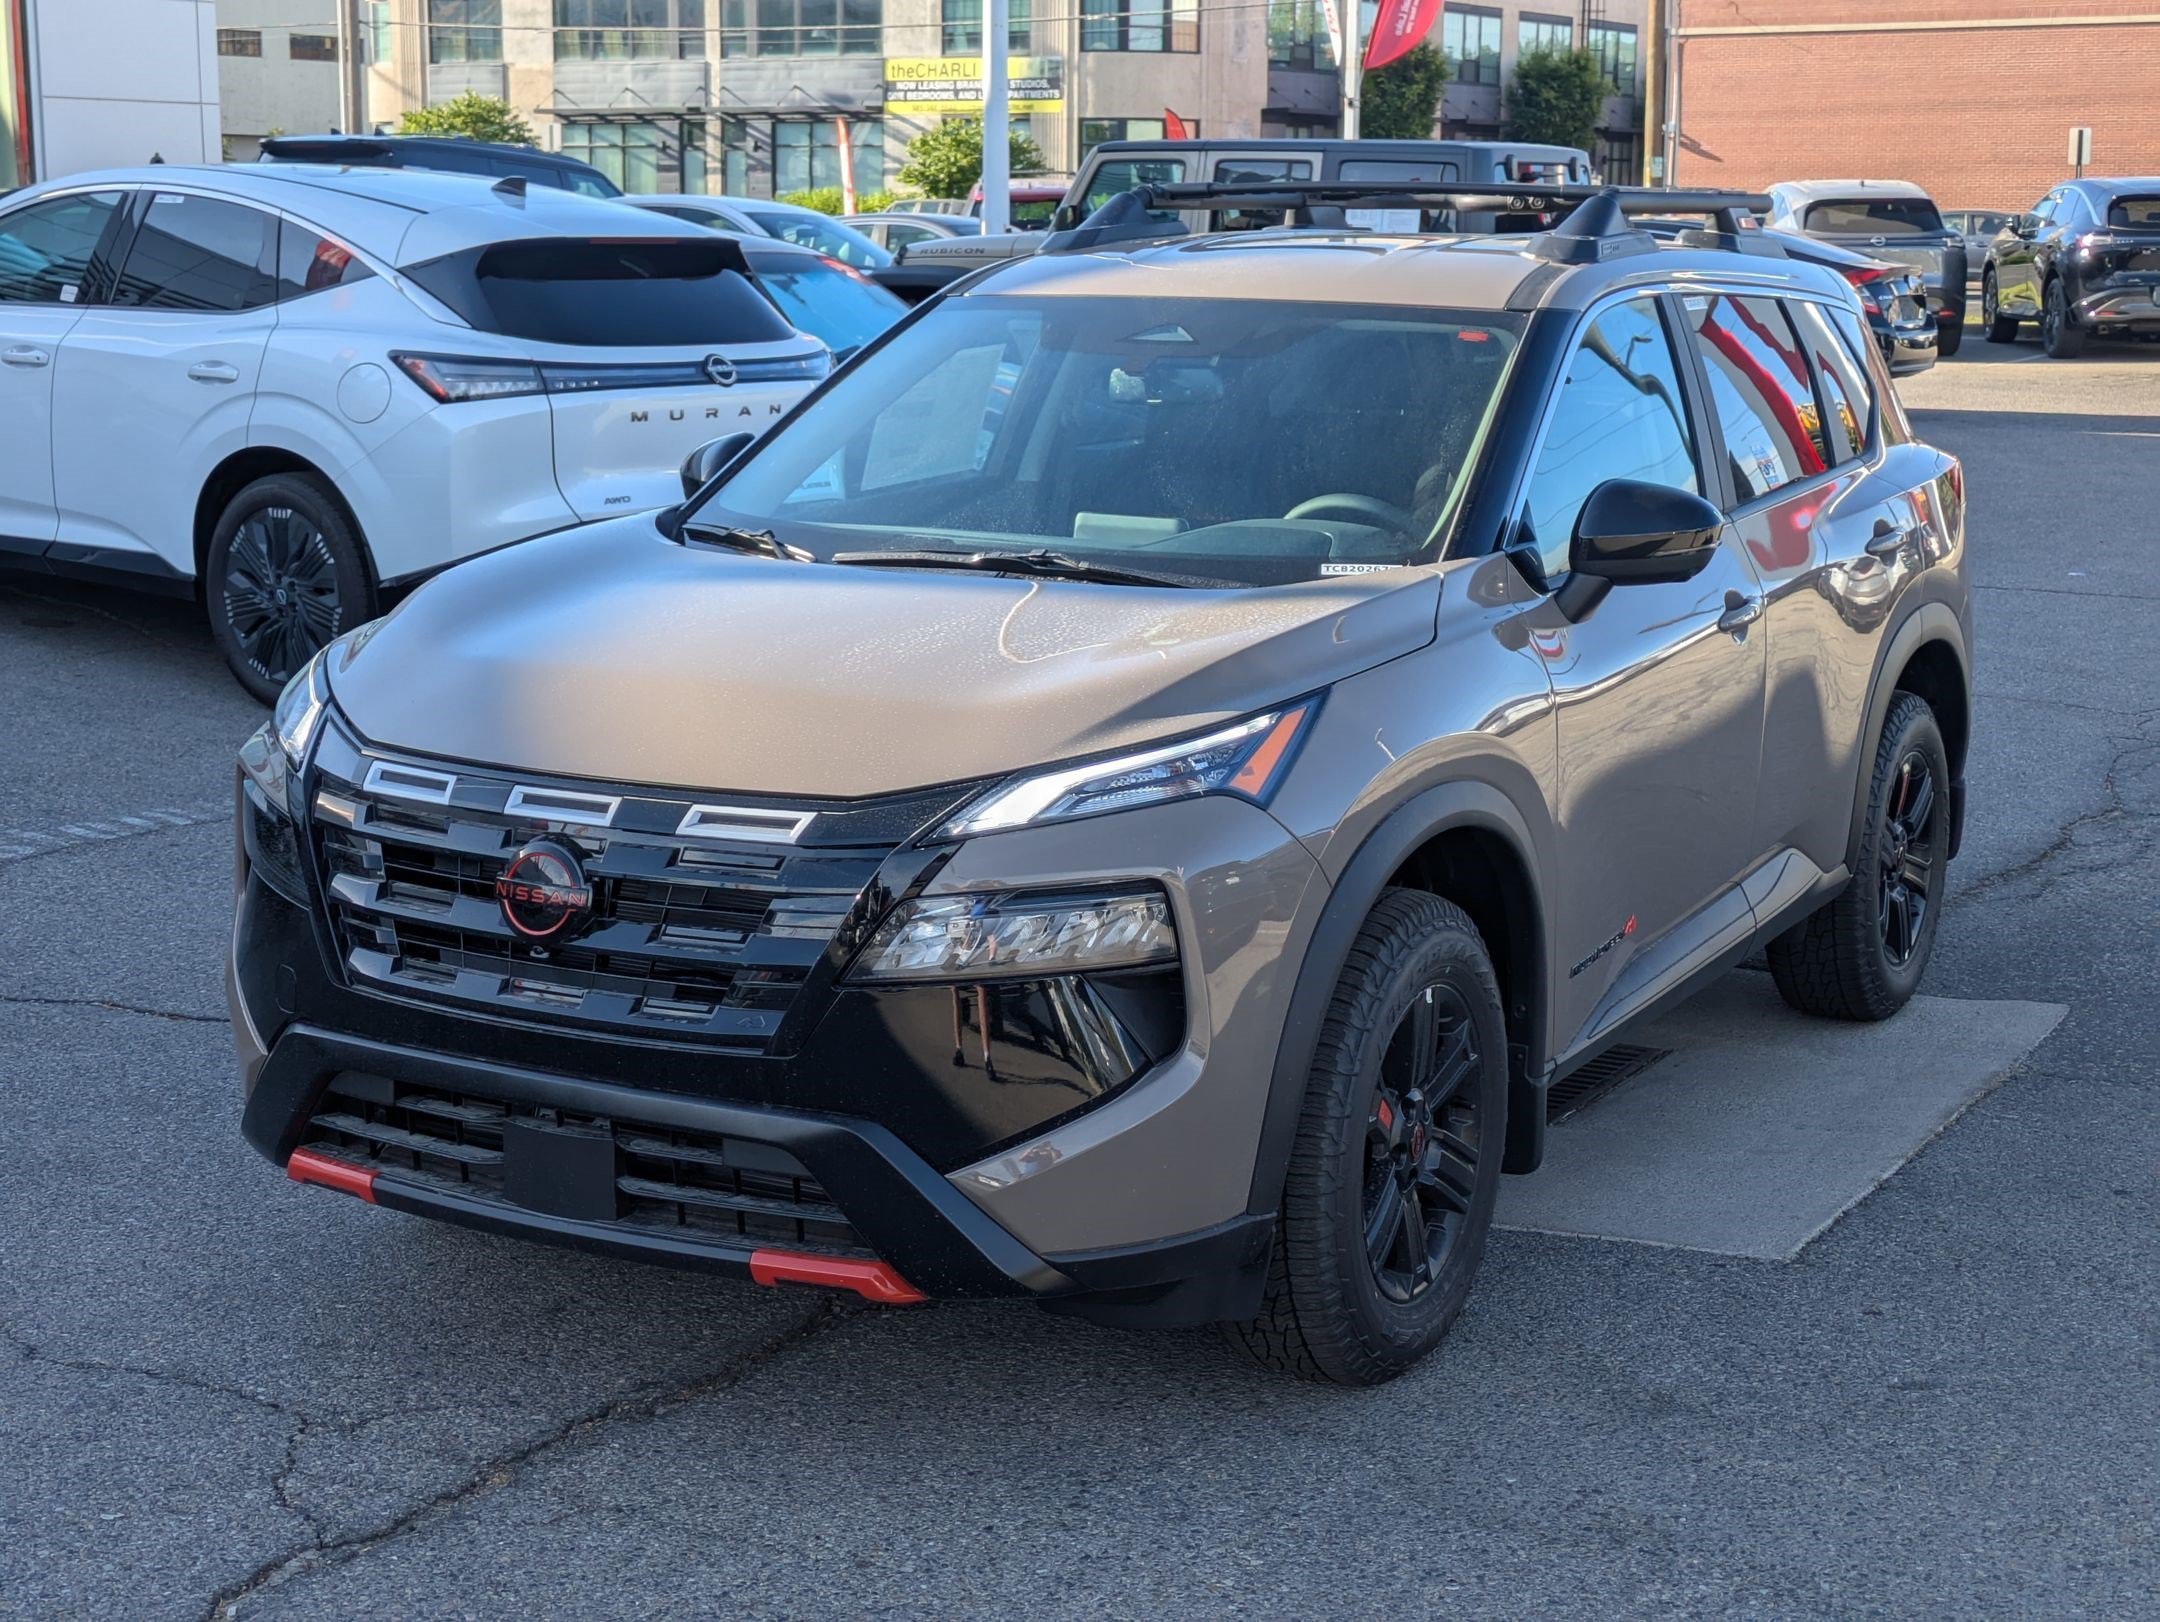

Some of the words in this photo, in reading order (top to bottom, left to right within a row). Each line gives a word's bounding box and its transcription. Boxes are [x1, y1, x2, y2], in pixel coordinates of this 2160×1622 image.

[896, 81, 918, 90] NOW
[918, 81, 955, 90] LEASING
[956, 80, 983, 90] BRAN
[958, 91, 976, 101] AND
[1007, 89, 1060, 98] PARTMENTS
[920, 247, 985, 255] RUBICON
[630, 403, 782, 423] MURAN
[604, 495, 631, 505] AWD
[496, 880, 585, 907] NISSAN
